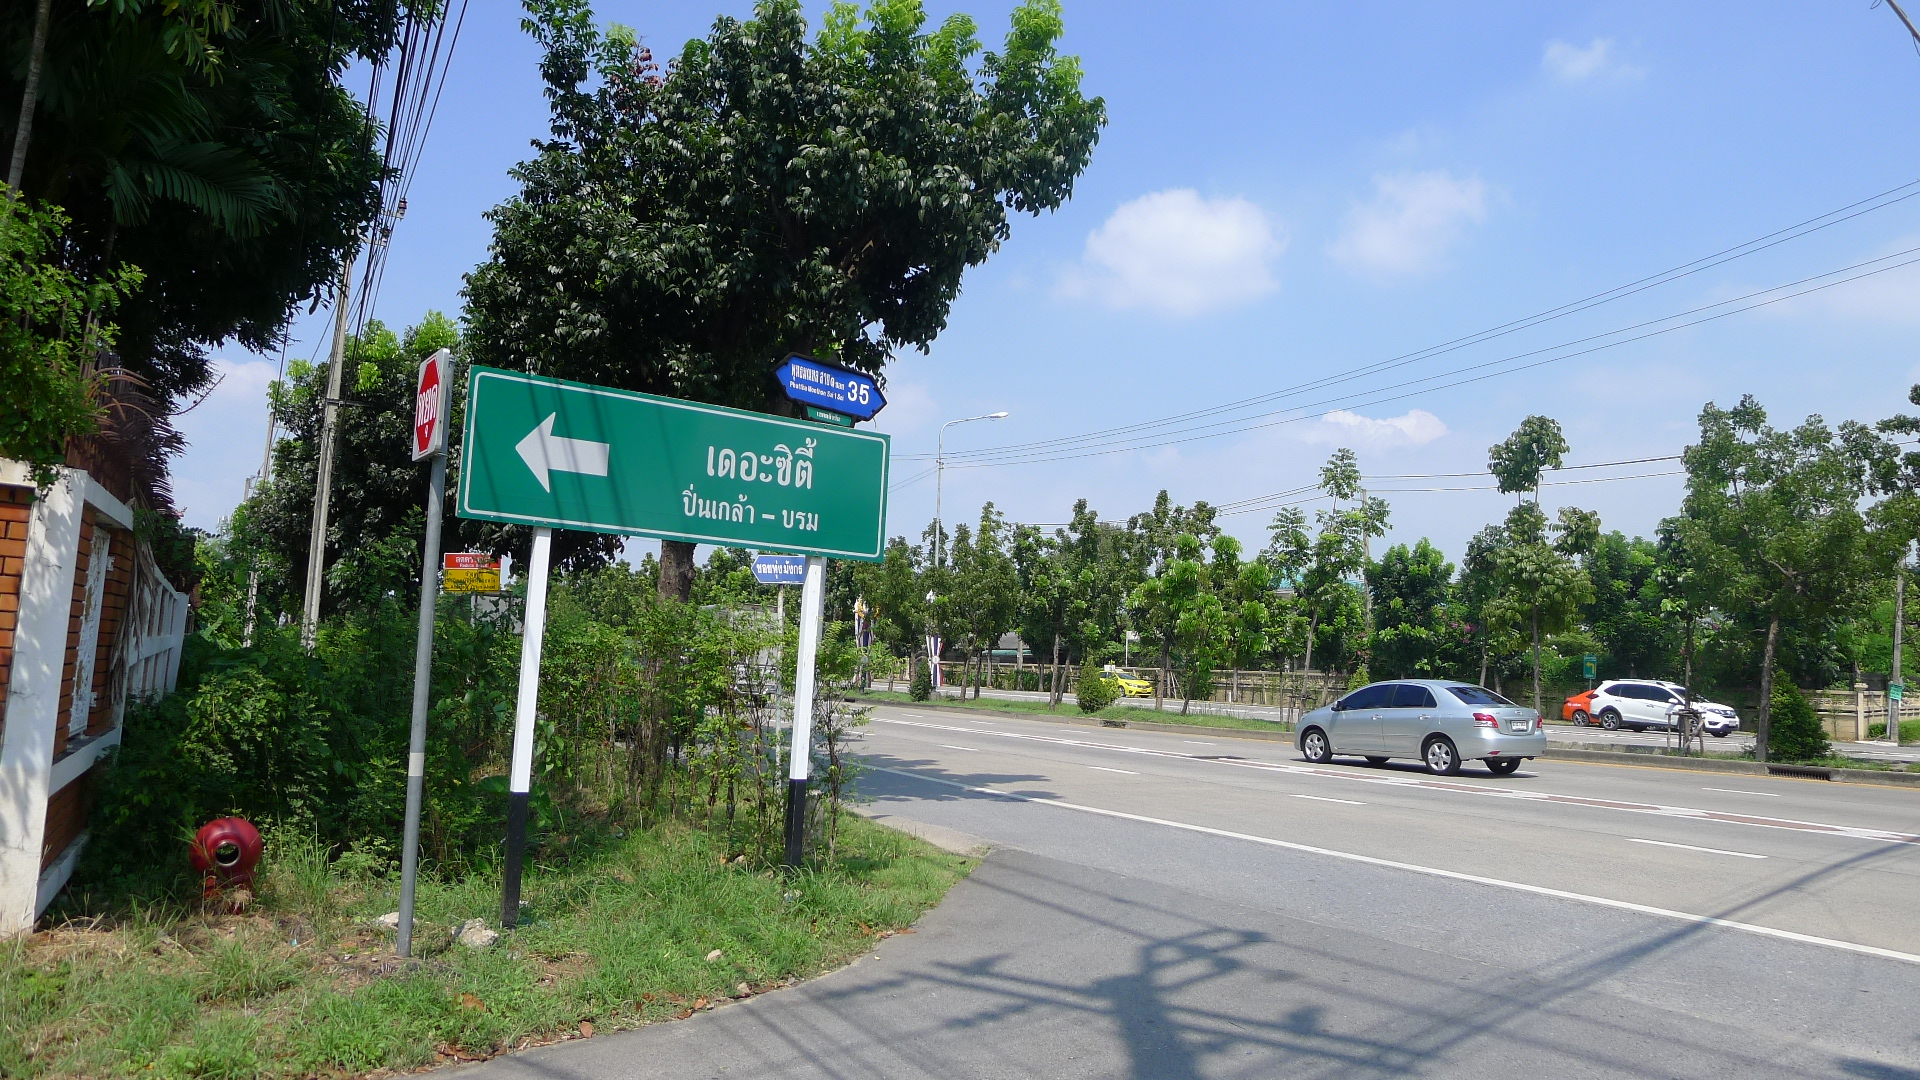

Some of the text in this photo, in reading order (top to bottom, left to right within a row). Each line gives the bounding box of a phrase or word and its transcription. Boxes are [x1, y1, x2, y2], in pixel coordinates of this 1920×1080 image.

[417, 384, 438, 437] หยุด
[847, 380, 870, 405] 35
[706, 437, 817, 490] เดอะซิตี้
[682, 483, 755, 524] ปิ่นเกล้า
[782, 509, 819, 532] บรม
